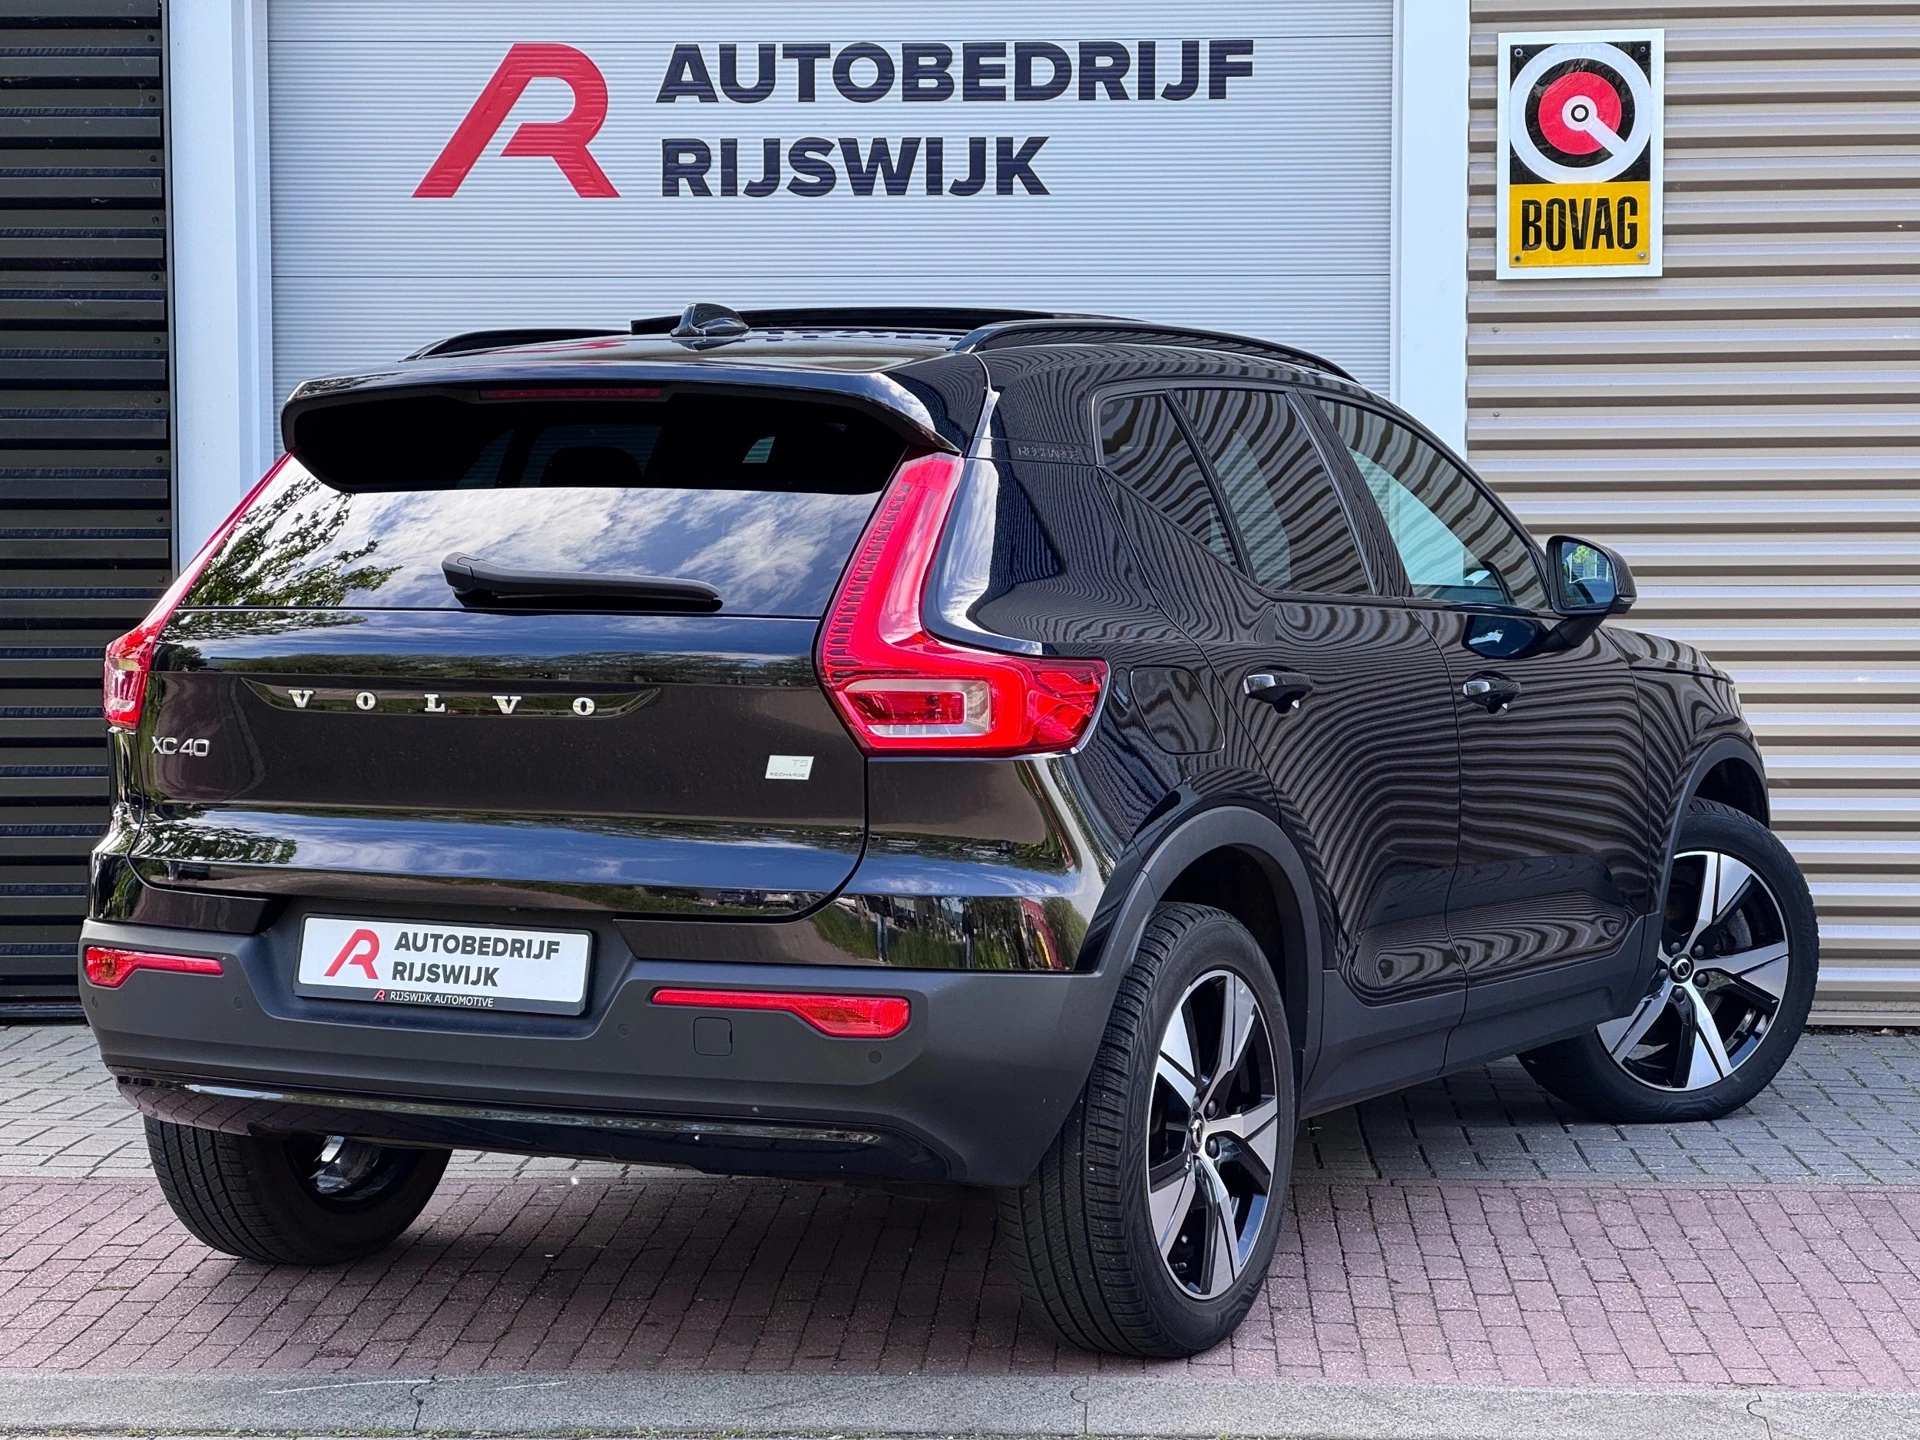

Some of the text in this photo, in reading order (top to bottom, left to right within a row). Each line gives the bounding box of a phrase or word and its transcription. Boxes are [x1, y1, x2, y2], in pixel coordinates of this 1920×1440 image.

[657, 39, 1254, 104] AUTOBEDRIJF
[661, 136, 1050, 198] RIJSWIJK
[1521, 196, 1638, 251] BOVAG
[288, 690, 595, 716] VOLVO
[151, 736, 210, 757] XC40
[394, 931, 560, 960] AUTOBEDRIJF
[391, 961, 500, 987] RIJSWIJK
[390, 991, 432, 1003] RIJSWIJK
[434, 994, 494, 1007] AUTOMOTIVE
